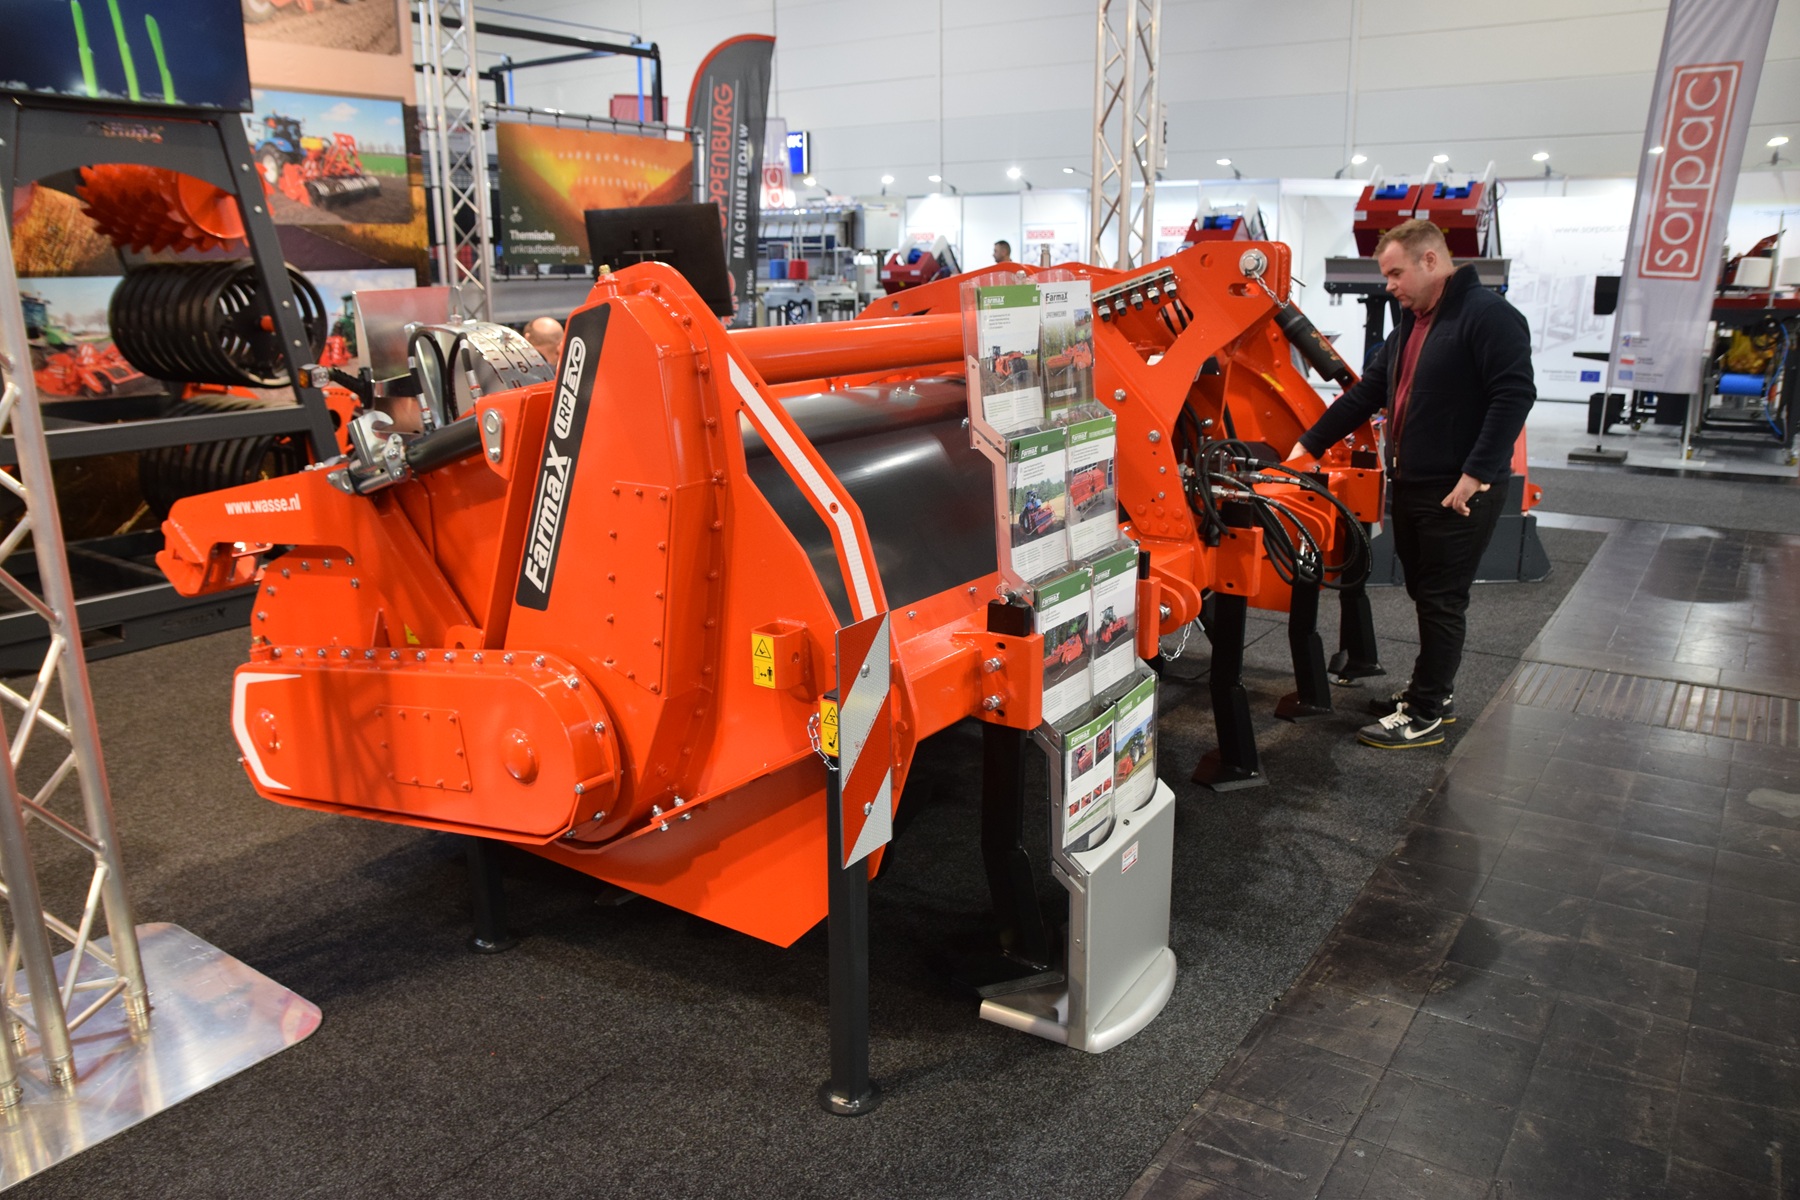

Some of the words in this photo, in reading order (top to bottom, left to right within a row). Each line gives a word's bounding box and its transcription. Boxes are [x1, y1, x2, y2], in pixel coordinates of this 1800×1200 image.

[733, 123, 750, 259] MACHINEBOUW
[1654, 76, 1722, 269] sorpac
[509, 229, 556, 241] Thermische
[516, 361, 529, 374] 5
[556, 396, 572, 434] LRP
[224, 493, 302, 515] www.wasse.nl
[524, 440, 571, 593] FarmaX
